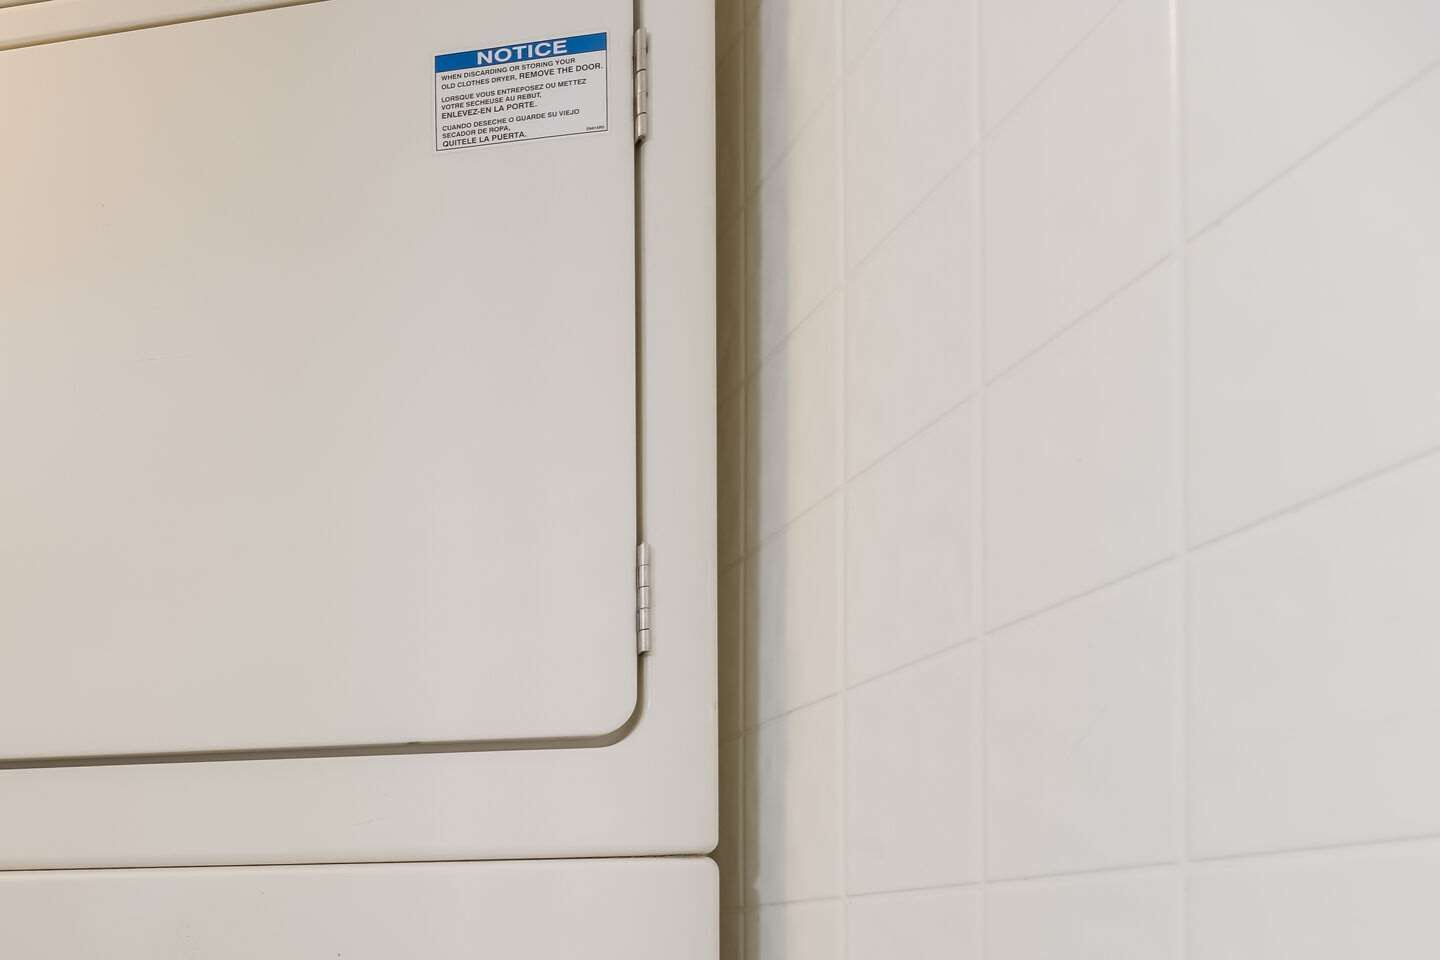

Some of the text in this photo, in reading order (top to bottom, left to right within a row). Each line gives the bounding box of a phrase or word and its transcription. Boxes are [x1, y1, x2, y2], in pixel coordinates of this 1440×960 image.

[476, 40, 568, 64] NOTICE
[440, 73, 462, 81] WHEN
[463, 66, 508, 78] DISCARDING
[521, 60, 554, 70] STORING
[554, 57, 576, 65] YOUR
[440, 62, 603, 90] OLD CLOTHES DRYER, REMOVE THE DOOR.
[440, 93, 475, 103] LORSQUE
[475, 90, 496, 98] VOUS
[496, 83, 544, 95] ENTREPOSEZ
[557, 78, 587, 87] METTEZ
[440, 102, 464, 110] VOTRE
[465, 96, 504, 107] SECHEUSE
[516, 91, 542, 100] REBUT,
[441, 100, 538, 119] ENLEVEZ-EN LA PORTE.
[441, 122, 472, 131] CUANDO
[473, 117, 508, 127] DESECHE
[515, 112, 546, 122] GUARDE
[558, 108, 580, 116] VIEJO
[441, 125, 512, 139] SECADOR DE ROPA,
[442, 130, 527, 147] QUITELE LA PUERTA.
